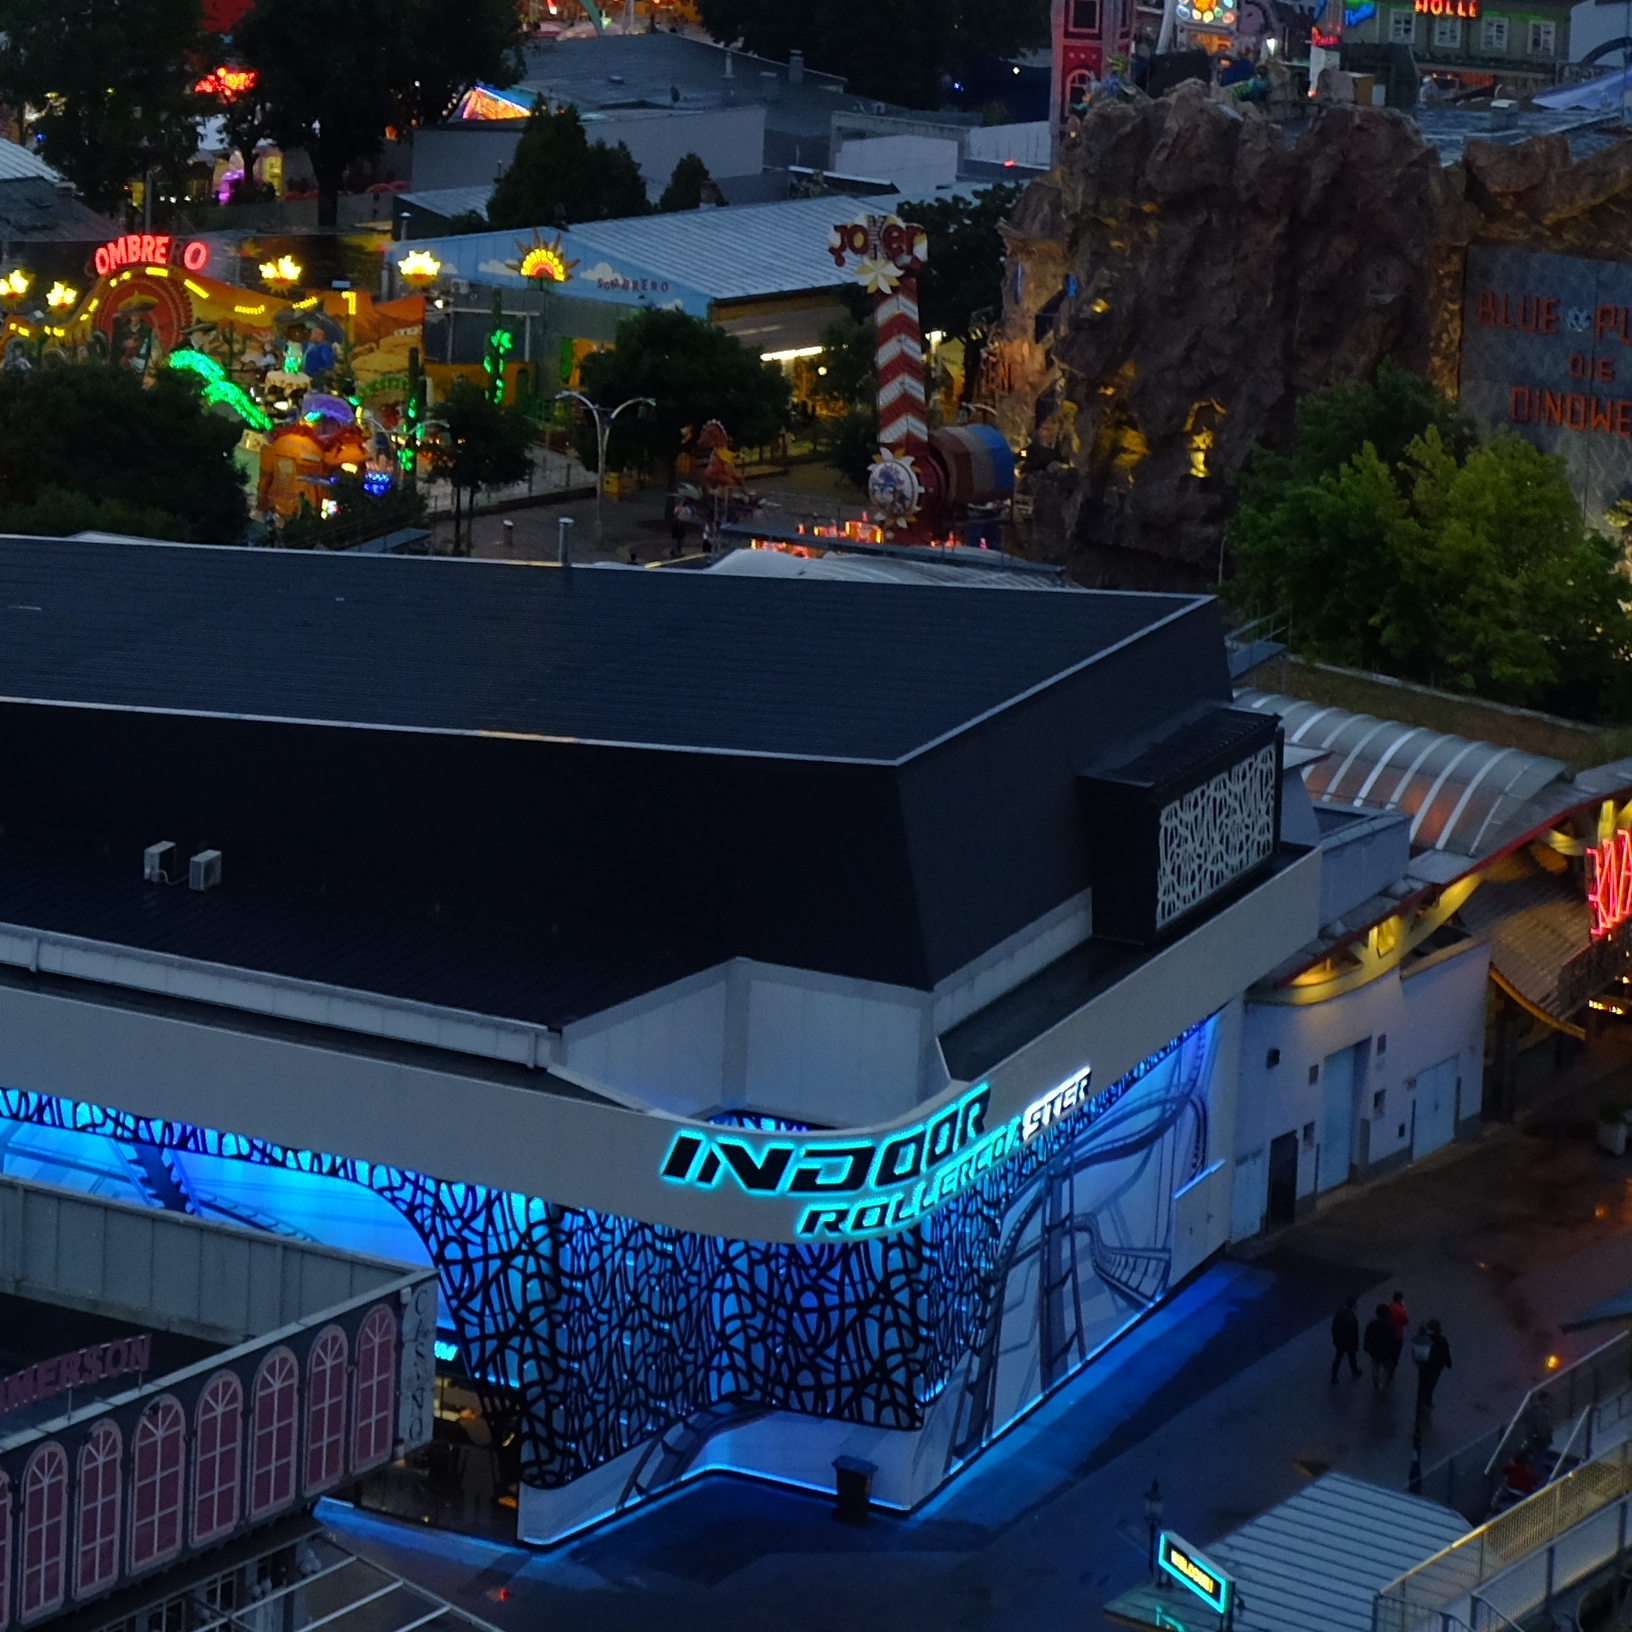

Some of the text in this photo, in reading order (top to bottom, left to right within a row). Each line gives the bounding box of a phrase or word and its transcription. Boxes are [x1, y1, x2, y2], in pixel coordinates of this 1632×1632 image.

[1476, 289, 1560, 337] BLUE
[1568, 352, 1616, 384] DIE
[660, 1081, 991, 1194] INDOOR
[796, 1066, 1092, 1238] ROLLERCOASTER
[409, 1289, 429, 1441] CASINO
